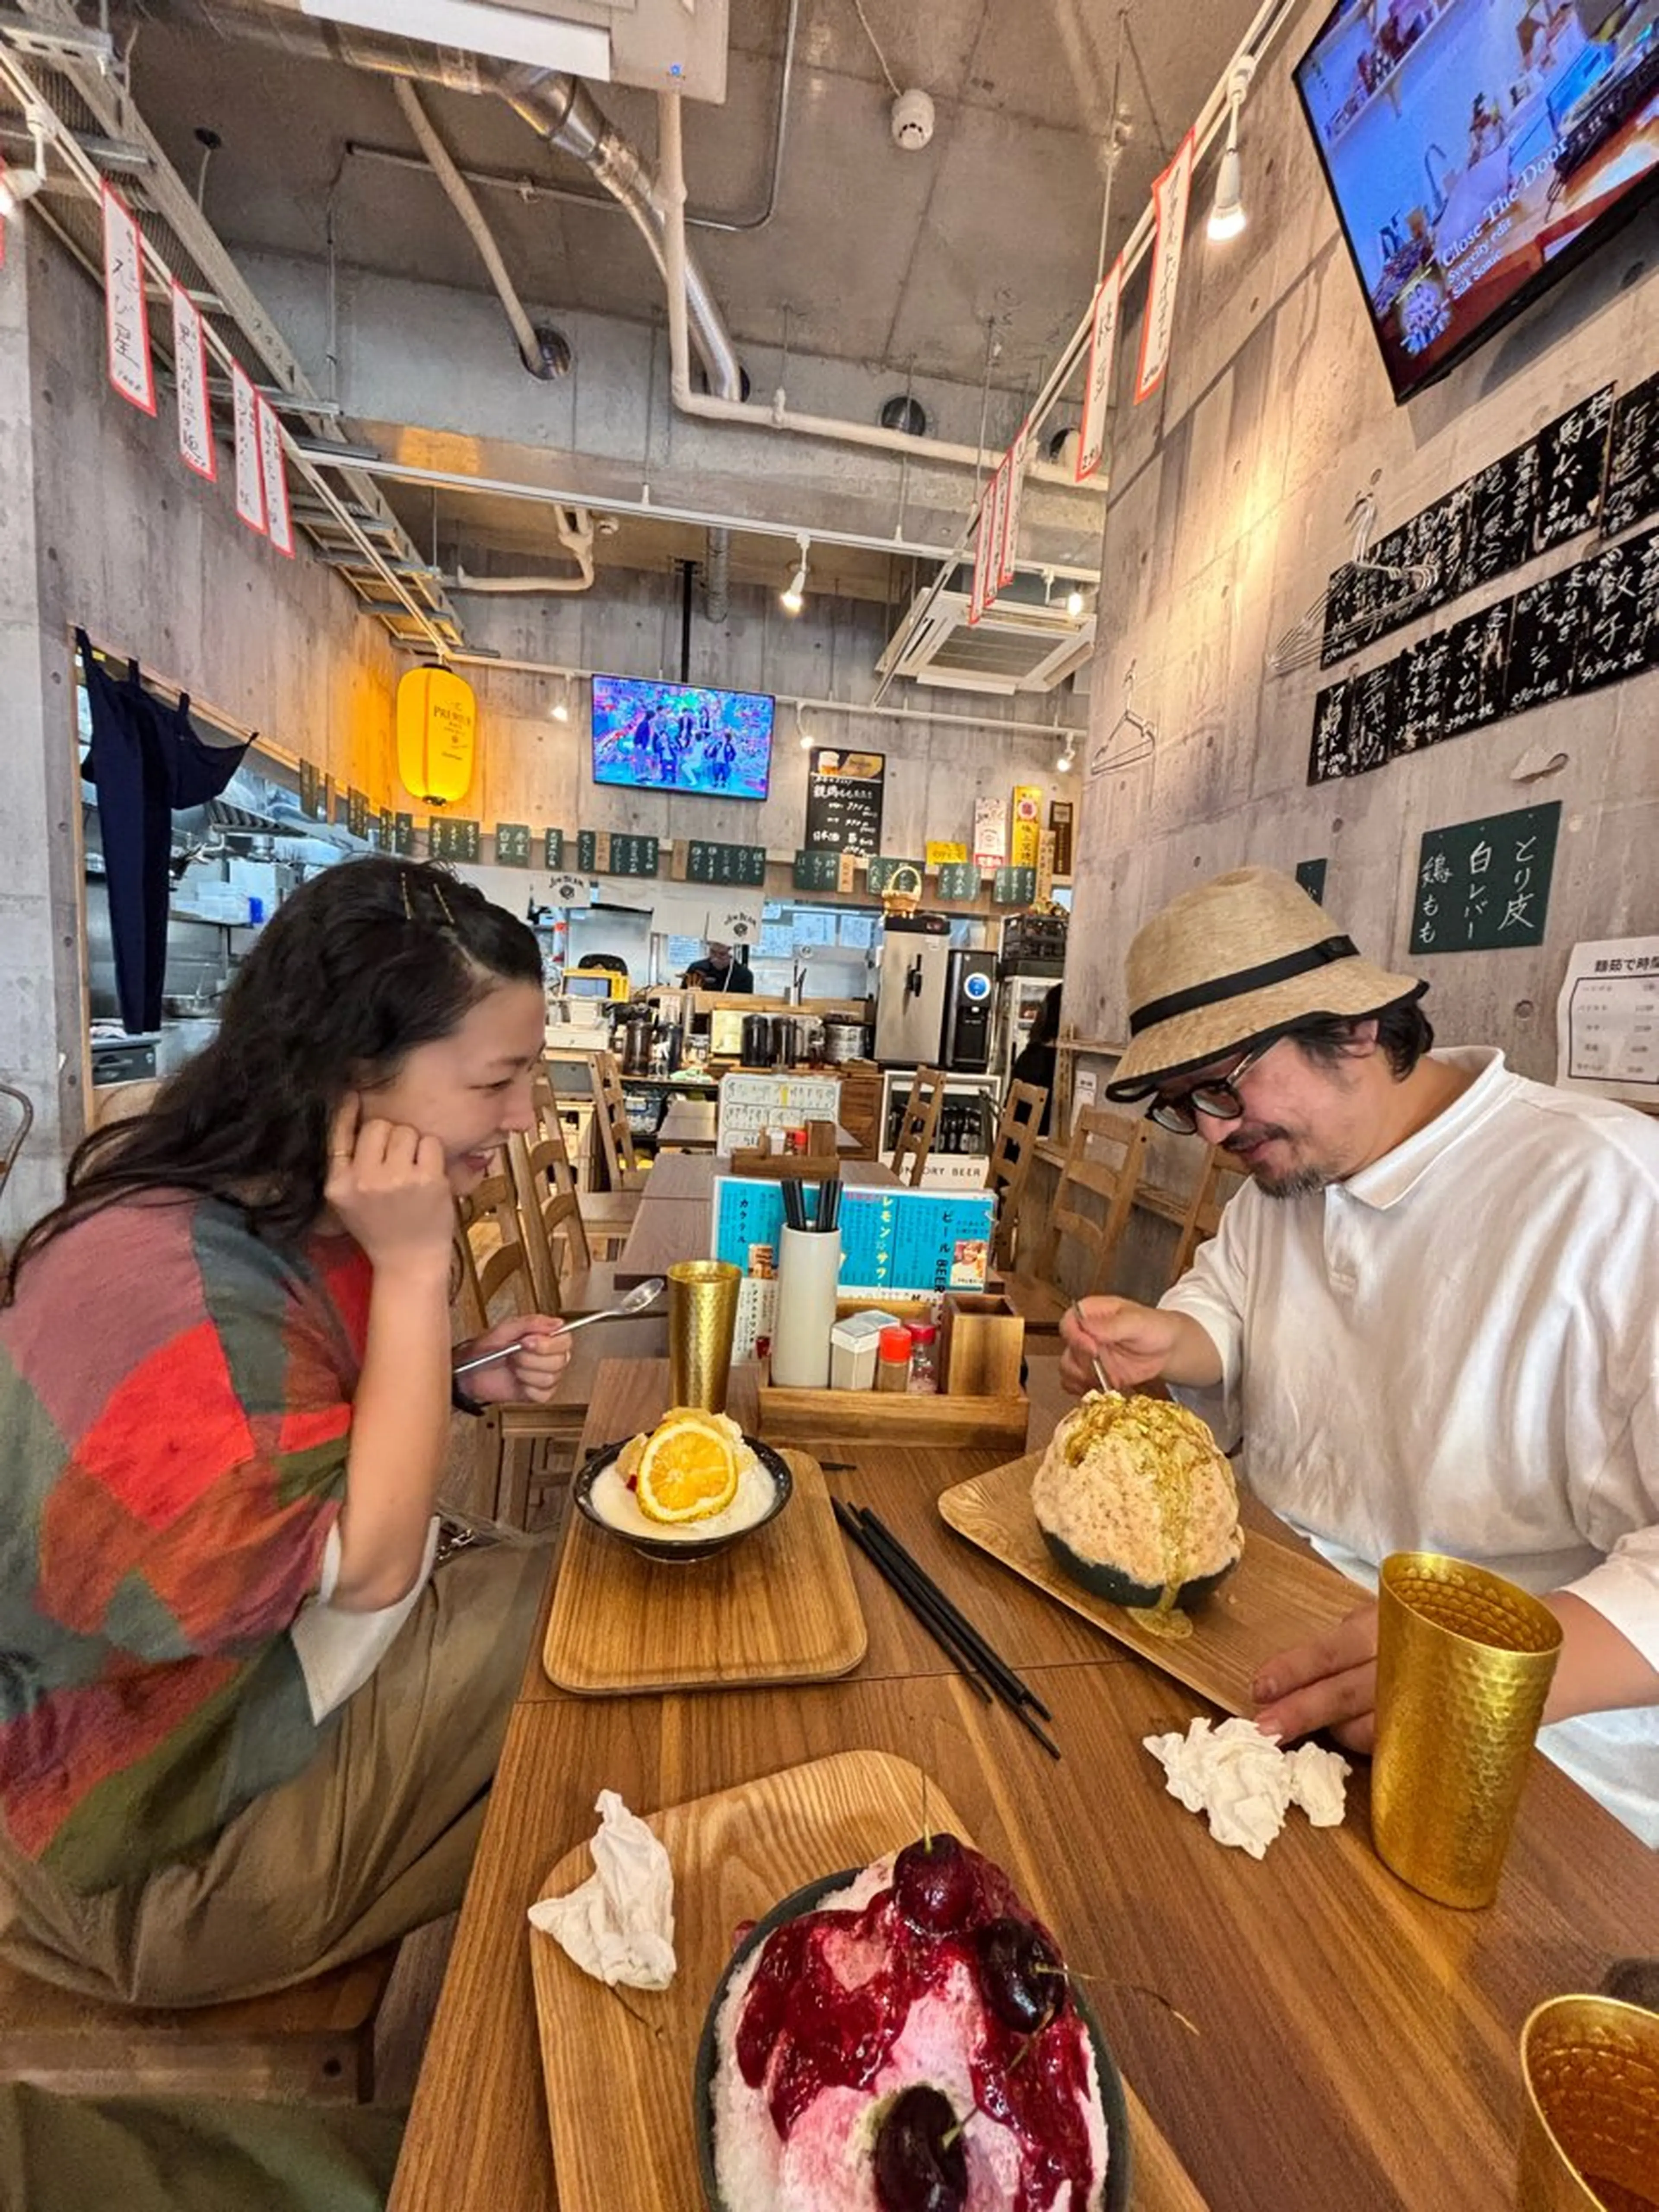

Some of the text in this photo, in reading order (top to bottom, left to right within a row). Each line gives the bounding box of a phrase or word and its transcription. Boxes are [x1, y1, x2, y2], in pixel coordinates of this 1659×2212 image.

[1441, 223, 1483, 268] Close
[1484, 188, 1519, 223] The
[1520, 137, 1568, 188] Door
[1419, 852, 1453, 944] 鶏もも
[1464, 840, 1492, 939] 白レバー
[1497, 836, 1536, 931] とり皮
[952, 1168, 980, 1176] BEER
[934, 1259, 949, 1294] BEER
[939, 1211, 953, 1253] ビール
